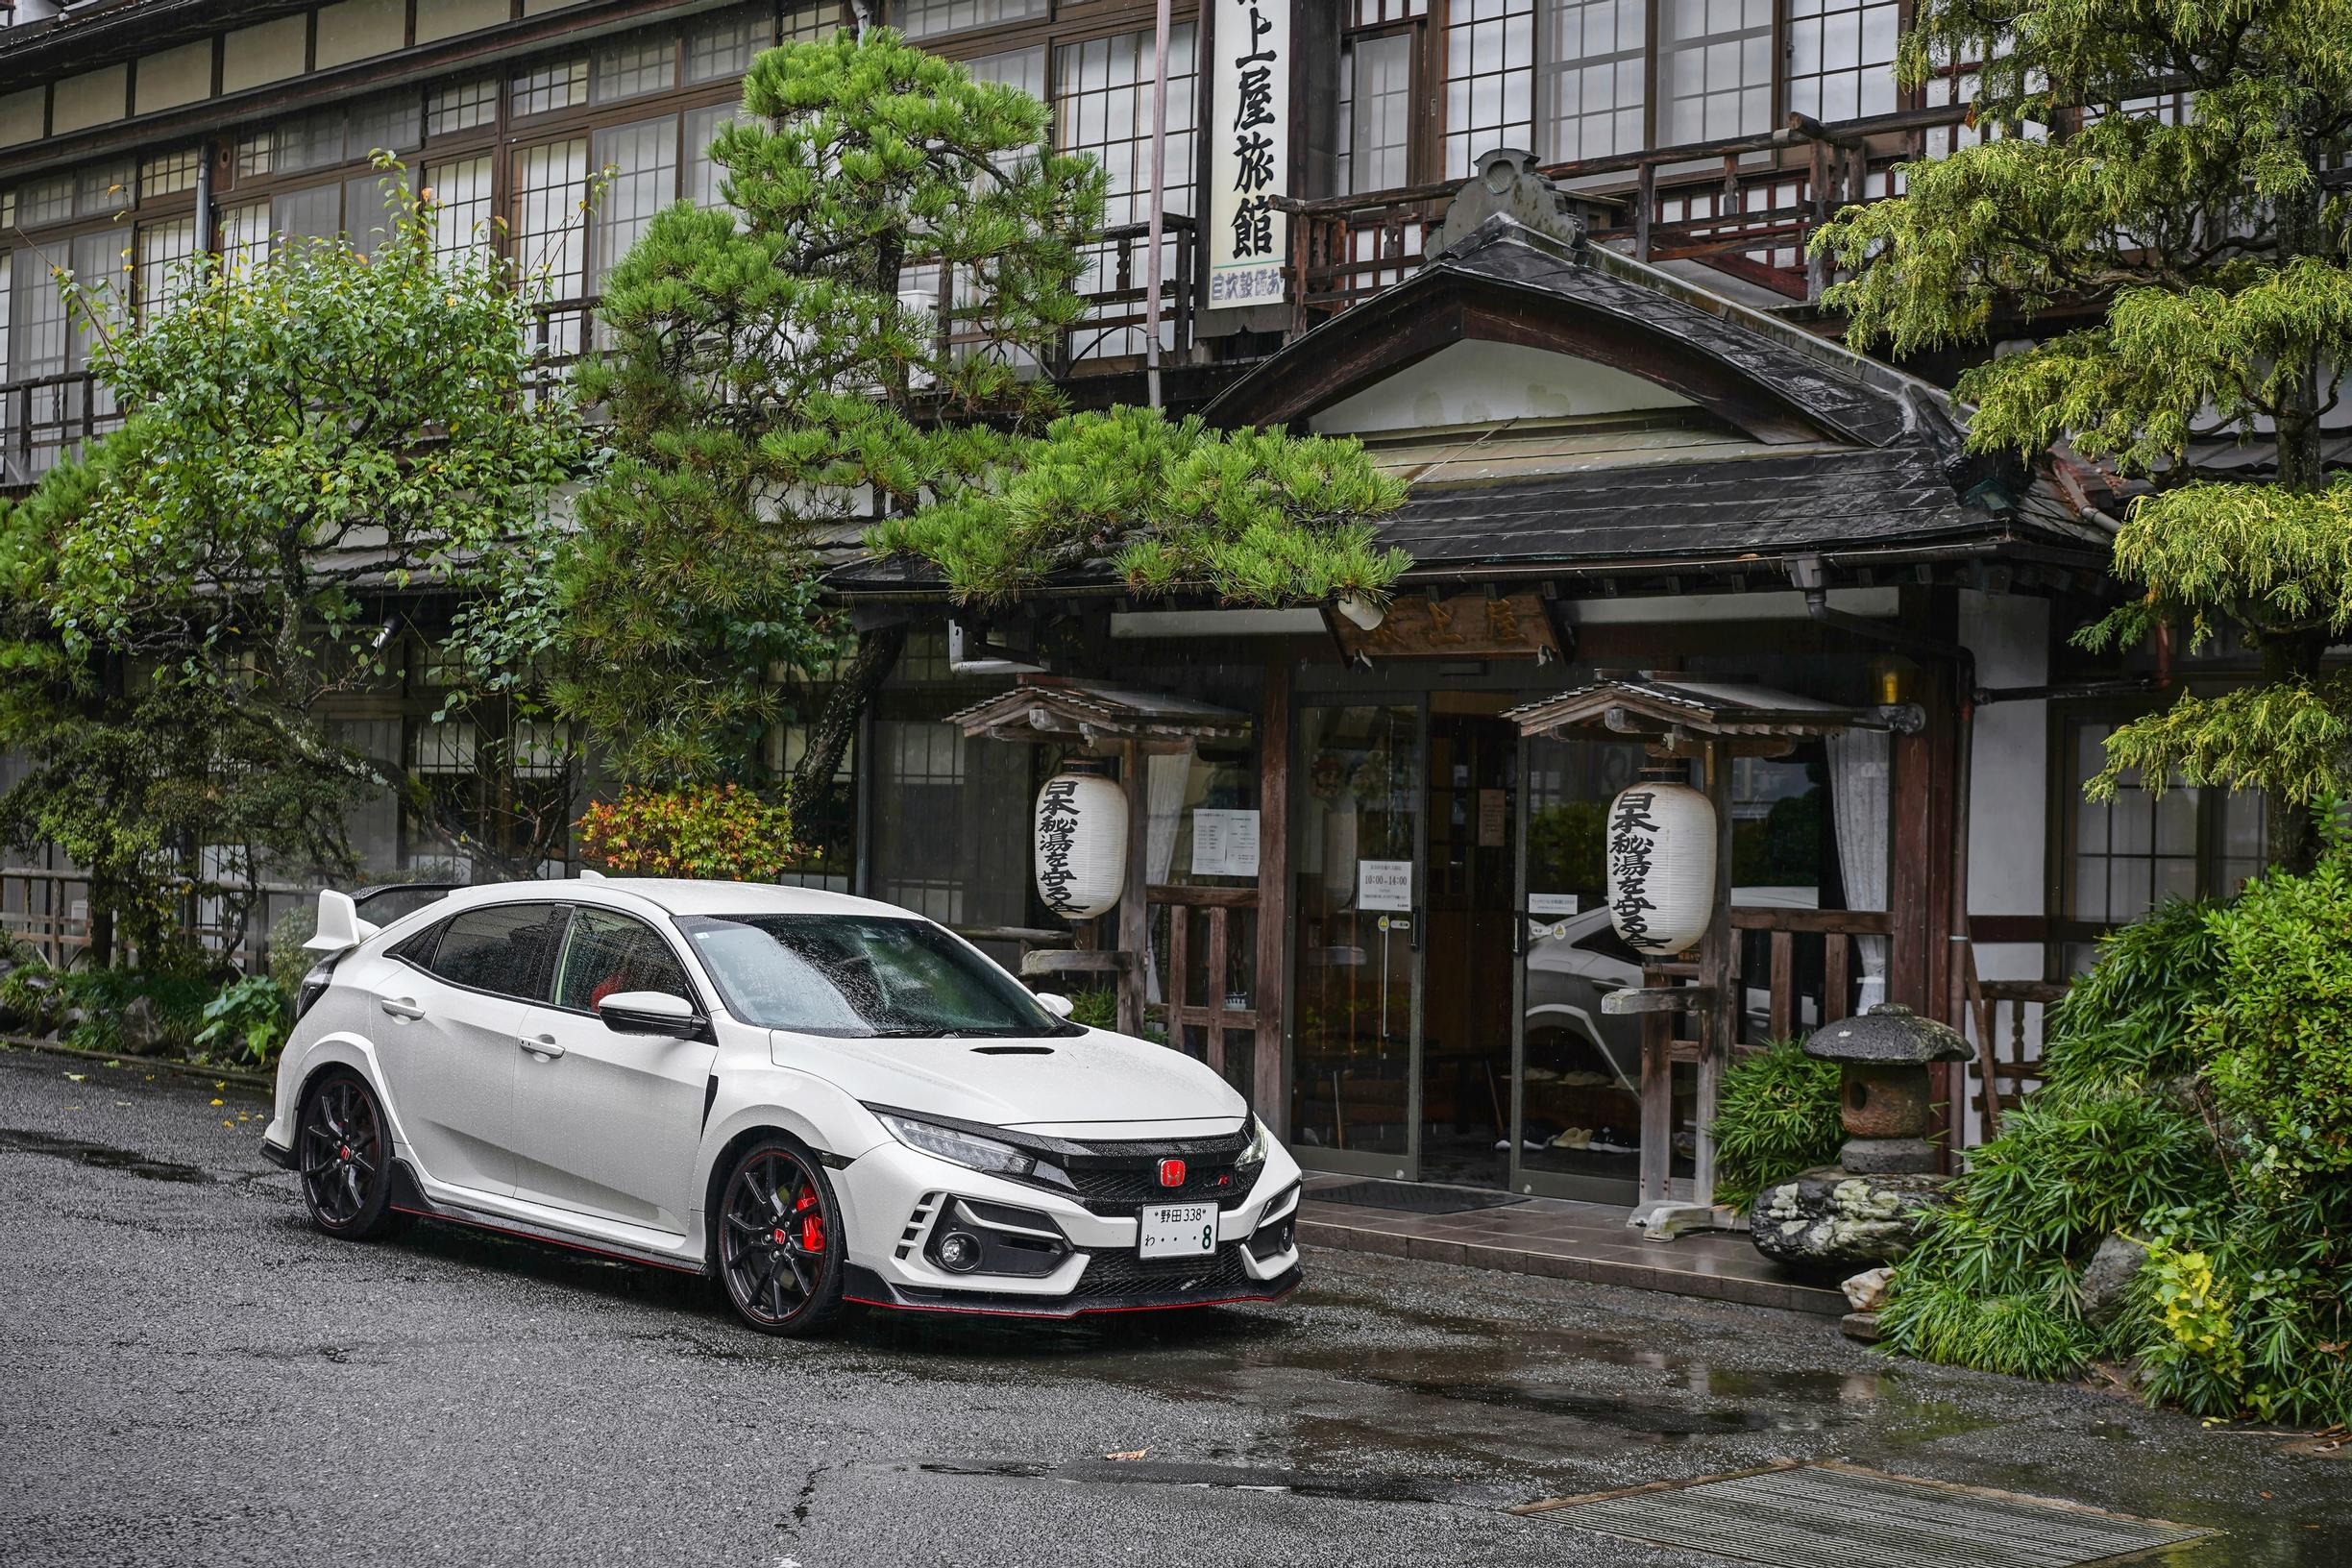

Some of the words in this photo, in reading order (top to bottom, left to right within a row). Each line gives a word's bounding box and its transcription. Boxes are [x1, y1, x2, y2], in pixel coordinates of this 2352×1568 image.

[1231, 0, 1278, 259] 上屋旅館
[1212, 269, 1284, 301] 自炊設備あ
[1038, 780, 1090, 914] 日本秘湯を守る会
[1608, 792, 1673, 949] 日本秘湯を守る会
